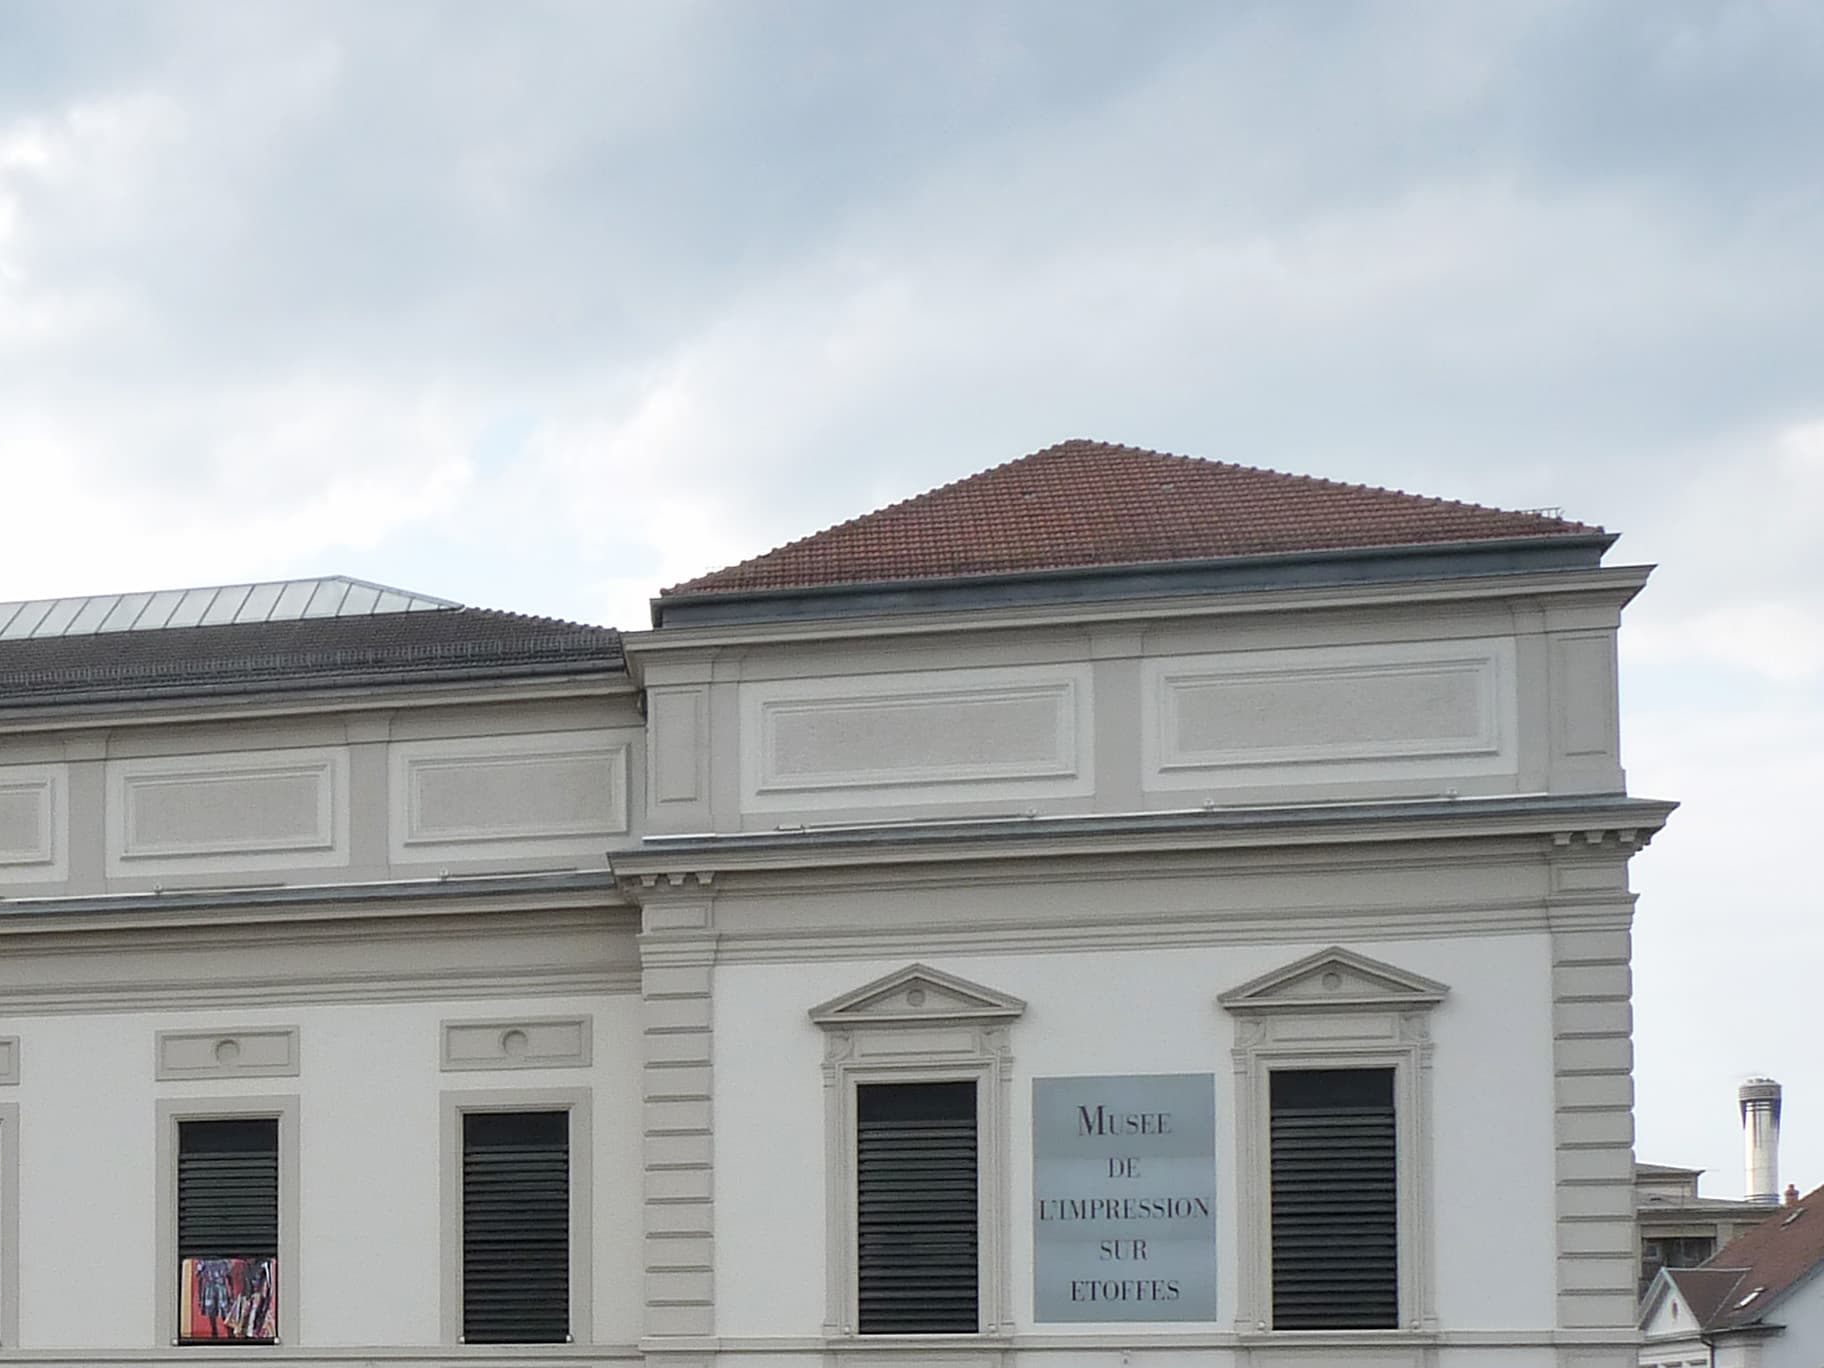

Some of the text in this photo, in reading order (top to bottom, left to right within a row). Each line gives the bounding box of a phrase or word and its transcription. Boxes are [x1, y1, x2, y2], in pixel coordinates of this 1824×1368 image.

[1079, 1104, 1171, 1136] MUSEE
[1108, 1157, 1141, 1179] DE
[1040, 1197, 1210, 1221] L'IMPRESSION
[1100, 1239, 1148, 1260] SUR
[1071, 1280, 1180, 1302] ETOFFES
